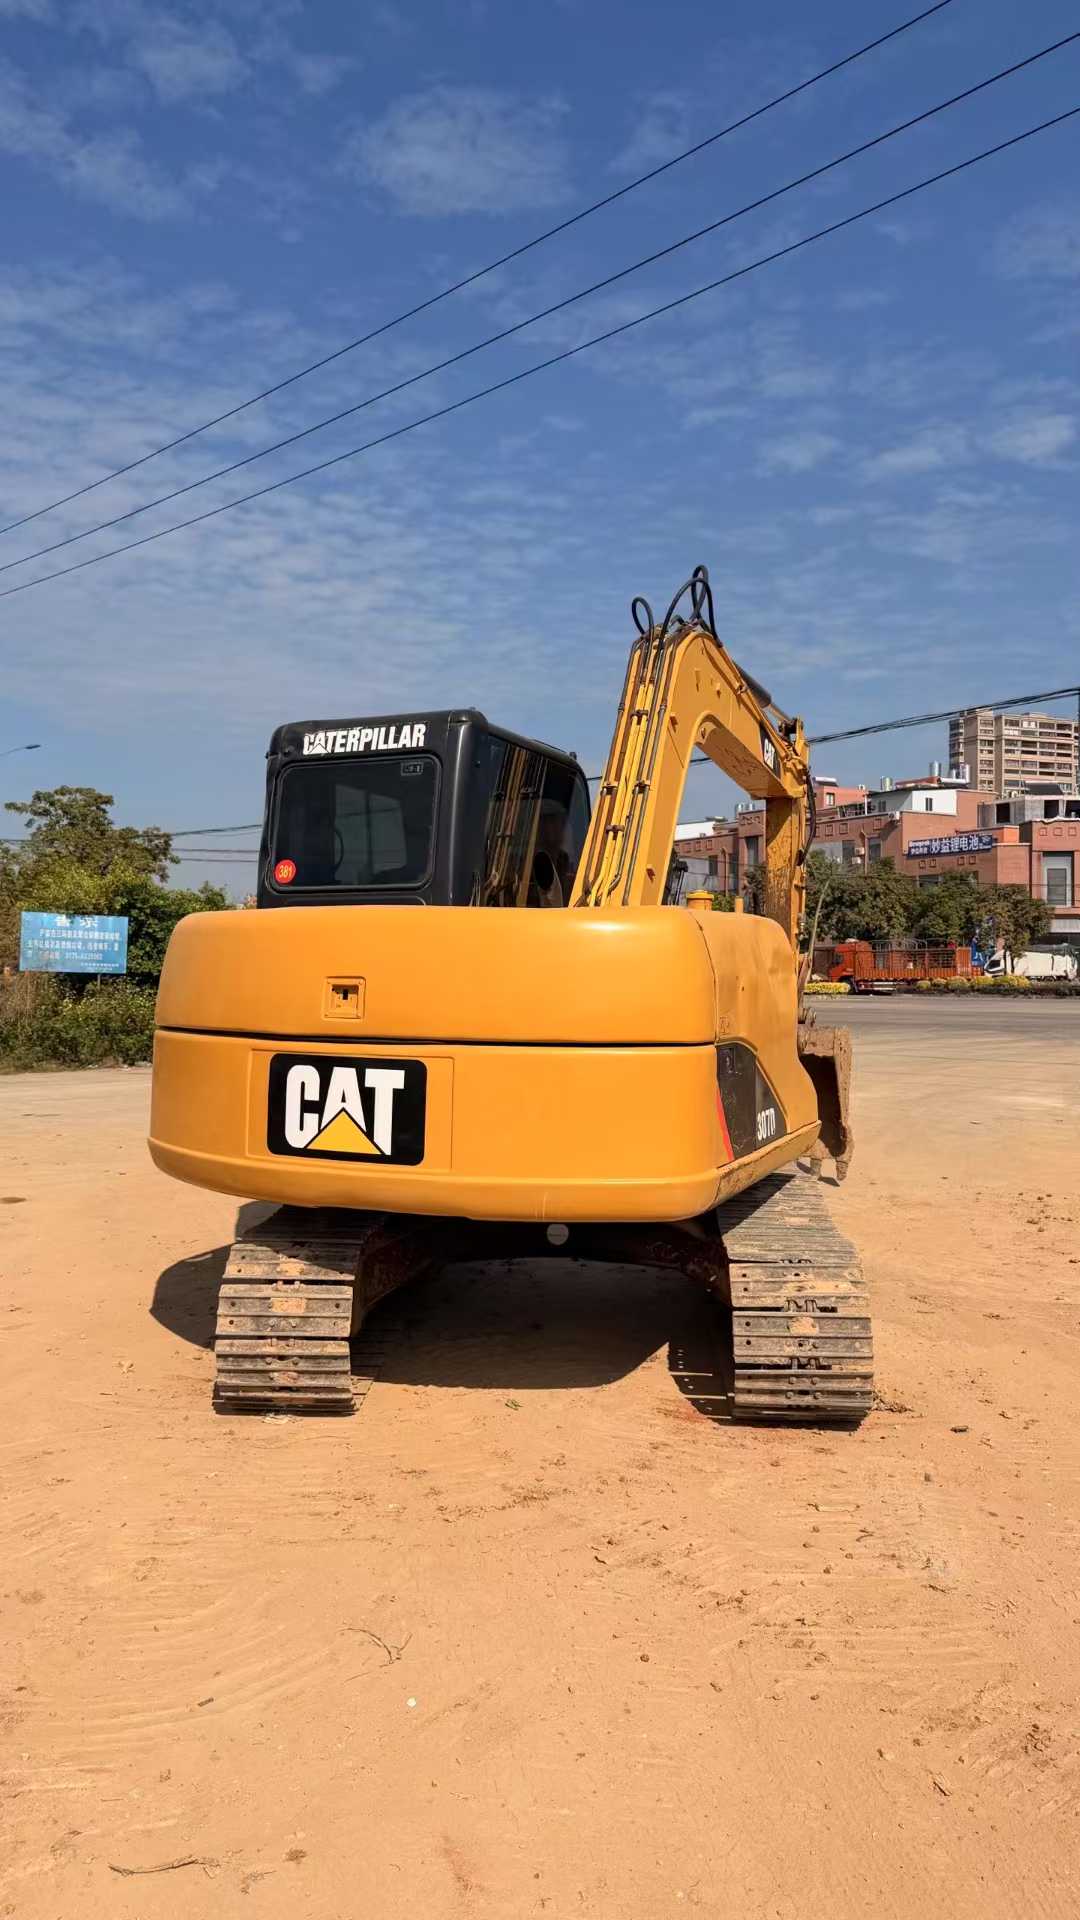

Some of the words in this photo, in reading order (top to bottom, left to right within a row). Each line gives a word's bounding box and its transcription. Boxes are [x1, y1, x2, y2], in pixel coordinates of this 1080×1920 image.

[302, 723, 426, 755] CATERPILLAR
[930, 834, 979, 854] 妙益锂电池
[279, 864, 293, 878] 381
[285, 1064, 405, 1155] CAT
